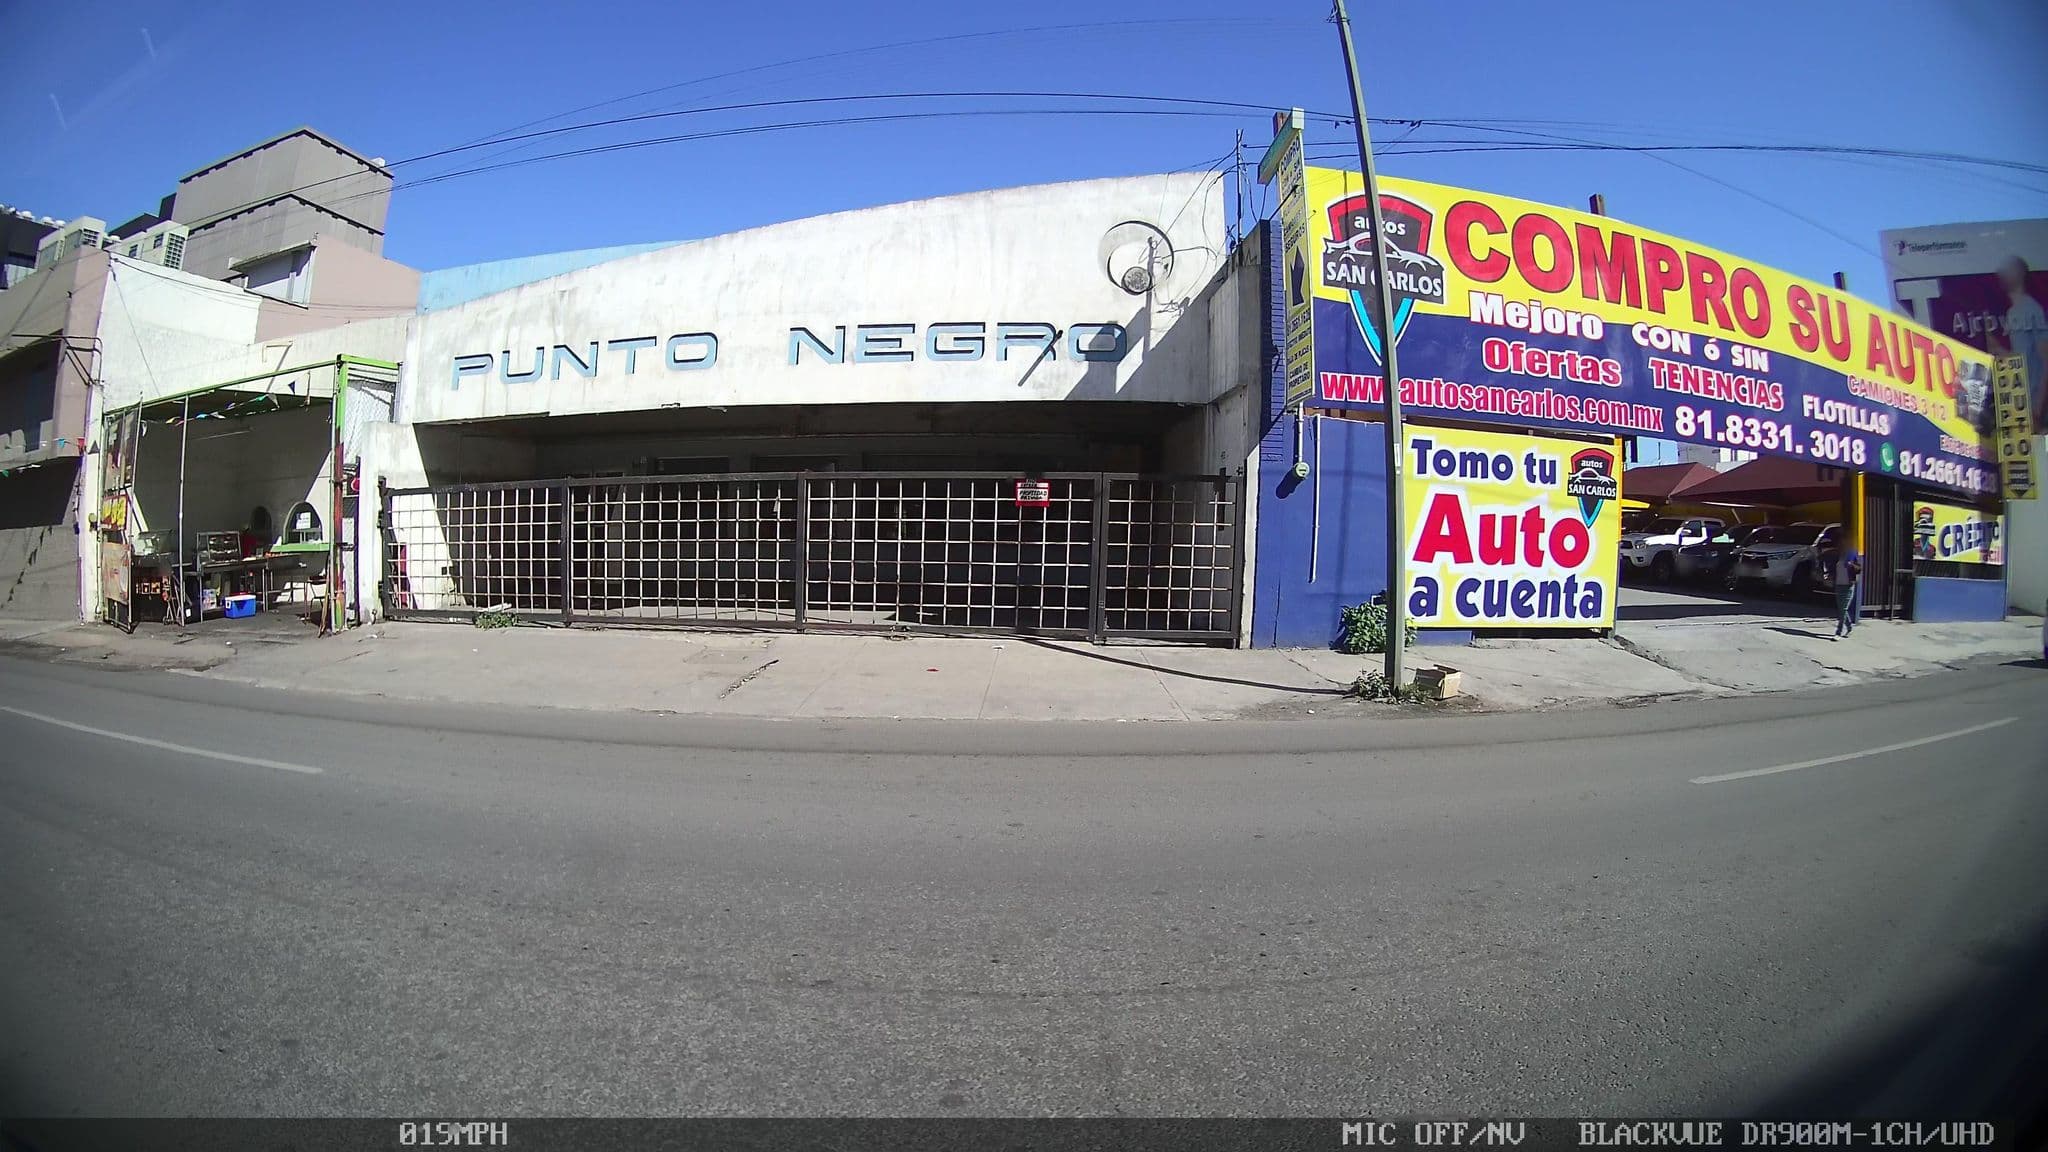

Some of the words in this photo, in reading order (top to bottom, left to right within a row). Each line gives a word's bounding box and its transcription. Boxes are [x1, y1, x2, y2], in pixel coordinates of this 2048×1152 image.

[1354, 216, 1406, 235] aos
[1326, 261, 1366, 285] SAN
[1370, 269, 1442, 297] ARLOS
[1444, 200, 1771, 339] COMPRO
[1787, 284, 1851, 362] SU
[1866, 313, 1963, 399] AUTO
[1467, 290, 1604, 341] Mejoro
[451, 332, 718, 391] PUNTO
[787, 322, 1128, 366] NEGRO
[1482, 338, 1622, 387] Ofertas
[1631, 322, 1692, 355] CON
[1730, 345, 1769, 373] SIN
[1320, 372, 1664, 432] wwwautosancarlos.com.mx
[1648, 357, 1784, 412] TENENCIAS
[1846, 374, 1919, 414] CAMIONES
[1675, 405, 1804, 454] 81.8331.
[1810, 430, 1867, 465] 3018
[1802, 394, 1891, 436] FLOTILLAS
[1411, 438, 1514, 481] Tomo
[1524, 452, 1557, 485] tu
[1581, 460, 1603, 469] autos
[1568, 483, 1585, 495] SAN
[1586, 485, 1617, 497] CARLOS
[1412, 493, 1590, 569] Auto
[1409, 576, 1439, 617] a
[1455, 573, 1603, 618] cuenta
